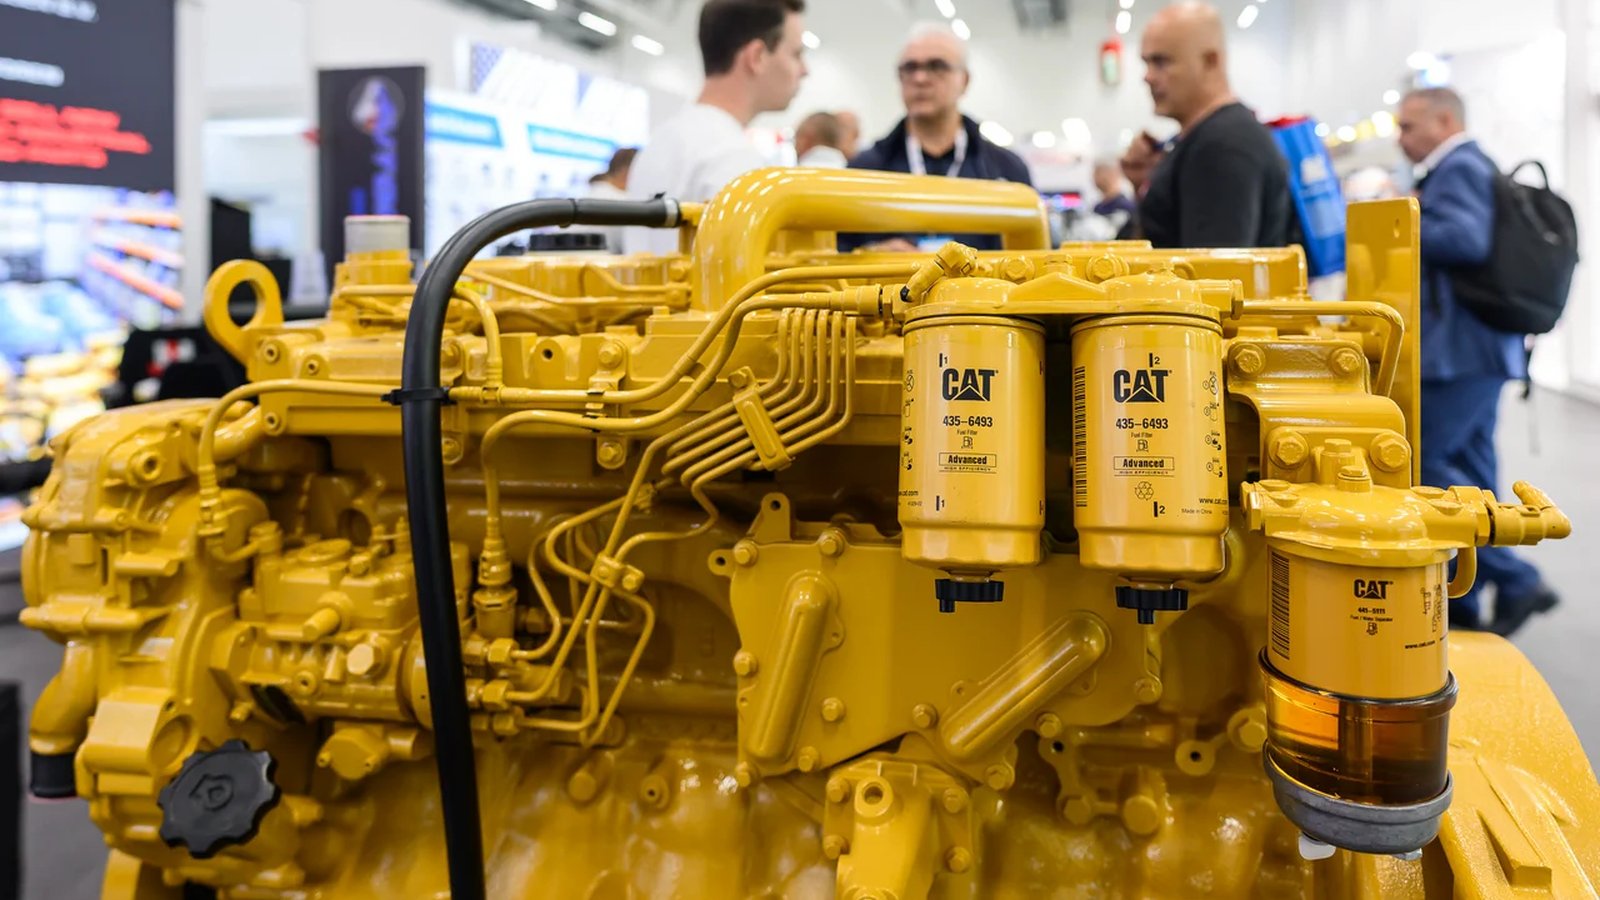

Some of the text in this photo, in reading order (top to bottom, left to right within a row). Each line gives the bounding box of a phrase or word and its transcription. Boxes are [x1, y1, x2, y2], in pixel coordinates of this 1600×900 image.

[942, 368, 996, 402] CAT
[1113, 369, 1169, 403] CAT
[943, 416, 993, 428] 435-6493
[1116, 418, 1168, 429] 435-6493
[948, 455, 988, 465] Advanced
[1122, 458, 1164, 468] Advanced
[1160, 506, 1166, 514] 2
[1354, 578, 1388, 600] CAT
